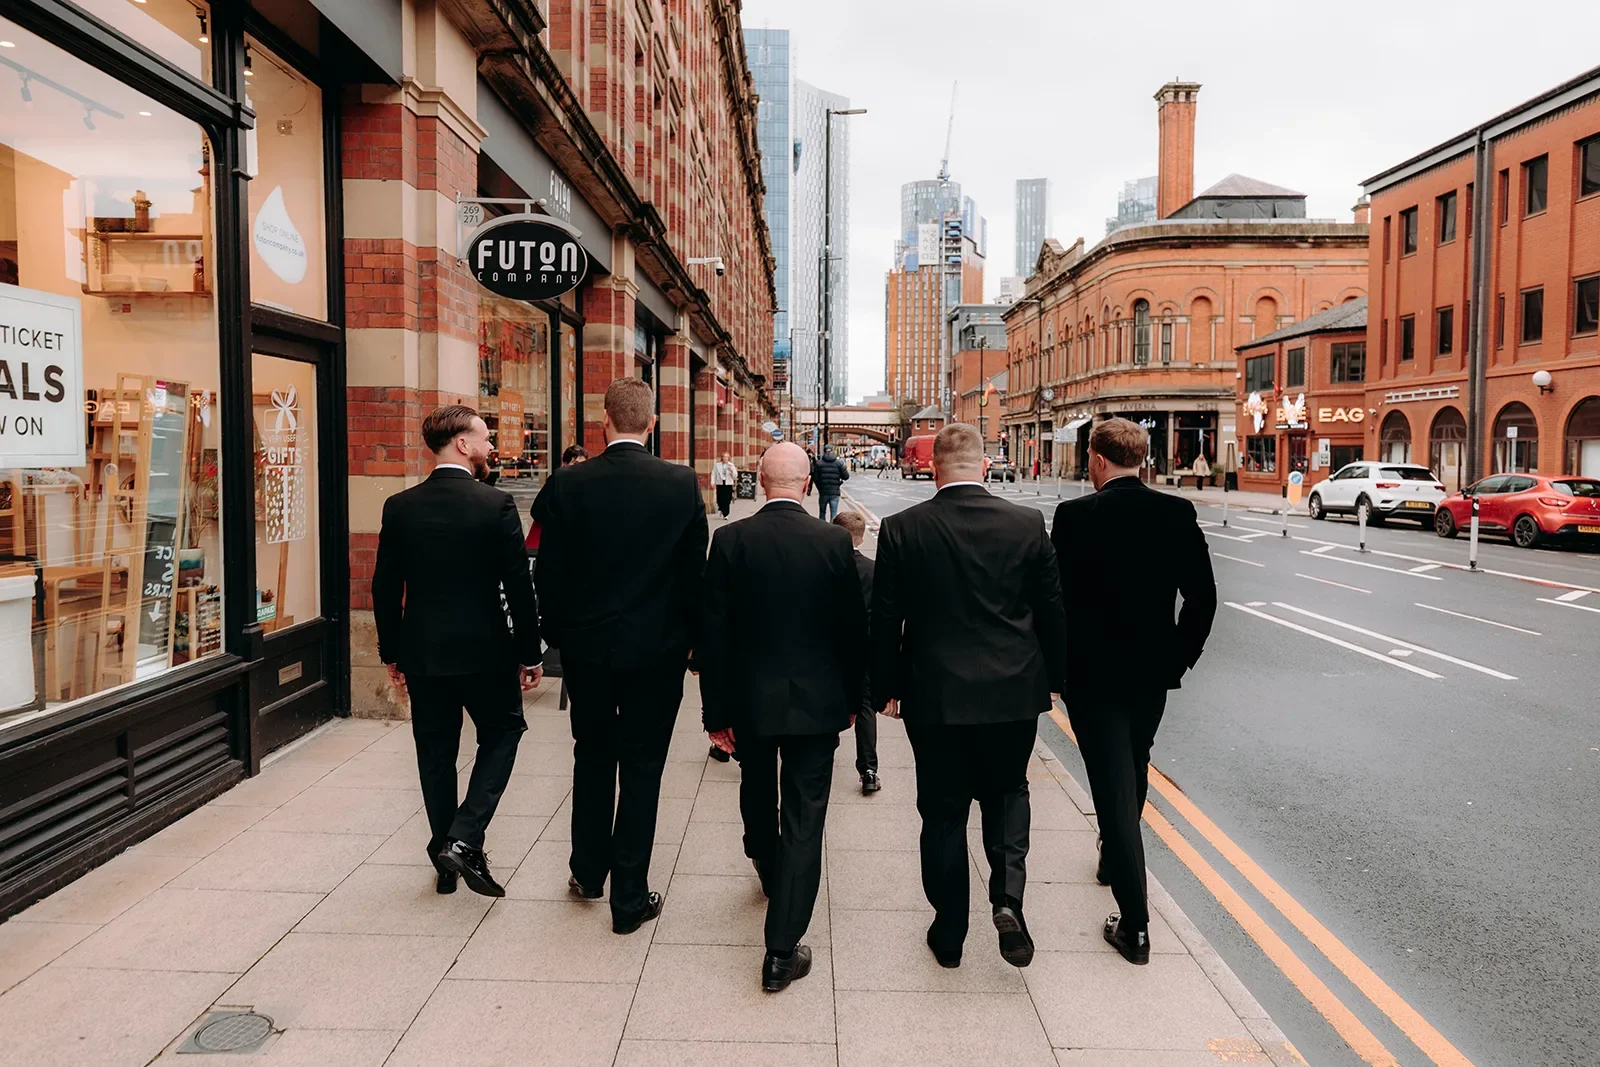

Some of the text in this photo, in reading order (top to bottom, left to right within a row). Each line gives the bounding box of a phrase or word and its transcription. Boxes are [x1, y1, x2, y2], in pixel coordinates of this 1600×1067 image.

[463, 206, 480, 214] 269
[463, 215, 479, 223] 271
[261, 221, 299, 243] SHOP ONLINE
[255, 233, 305, 257] futoncompany.co.uk
[477, 239, 578, 272] FUTON
[477, 271, 577, 285] COMPANY
[0, 324, 64, 351] TICKET
[1120, 403, 1157, 411] TAVERNA
[14, 415, 43, 436] ON
[267, 446, 303, 465] GIFTS
